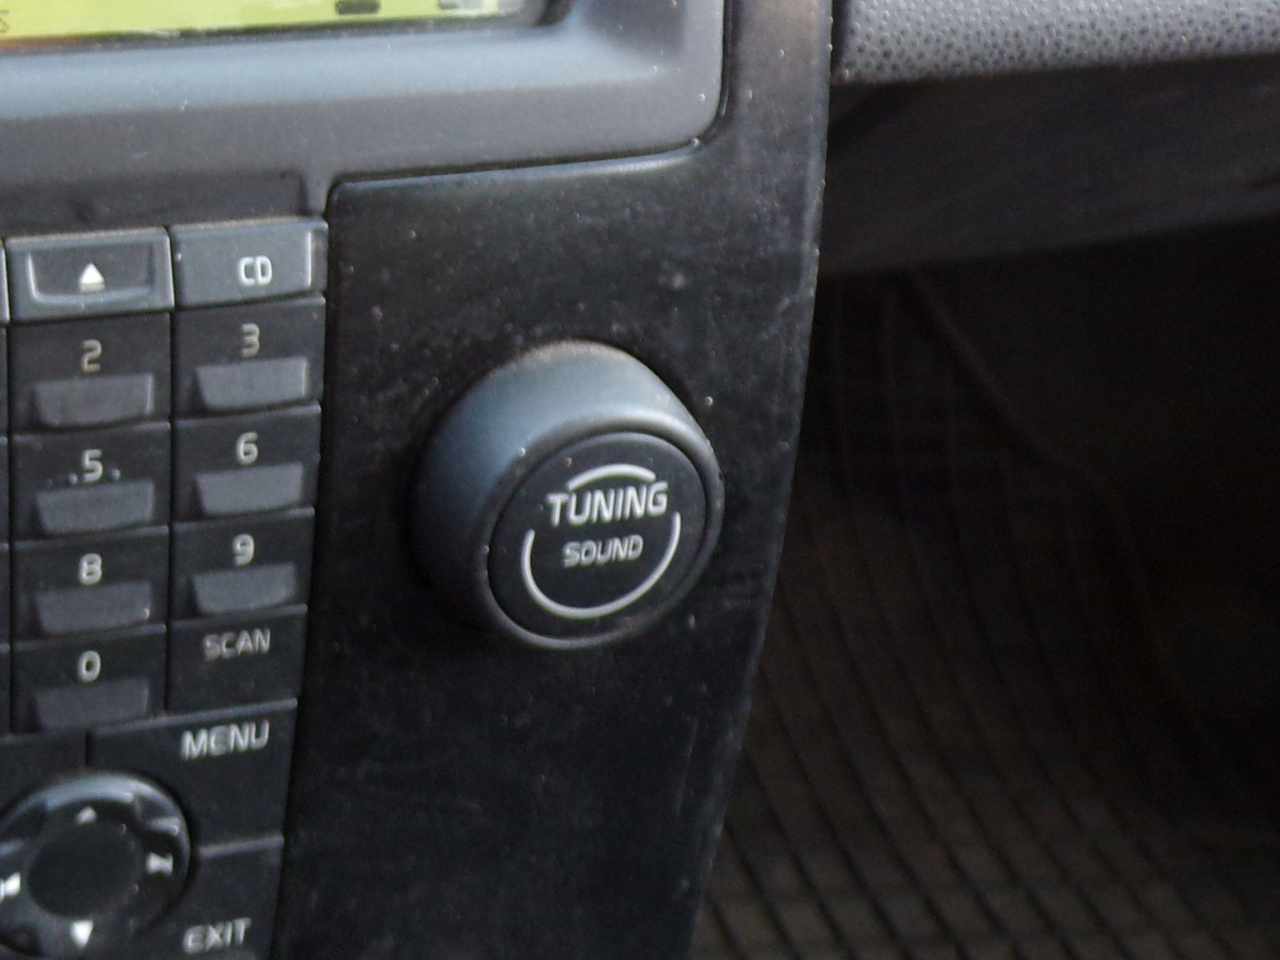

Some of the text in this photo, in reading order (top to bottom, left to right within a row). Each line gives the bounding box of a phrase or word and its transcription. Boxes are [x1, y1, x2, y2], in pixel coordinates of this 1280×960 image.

[238, 255, 274, 288] CD
[80, 339, 103, 373] 2
[240, 322, 262, 358] 3
[235, 431, 259, 465] 6
[81, 449, 104, 483] 5
[547, 481, 669, 527] TUNING
[233, 533, 256, 566] 9
[563, 534, 644, 568] SOUND
[78, 553, 103, 585] 8
[204, 628, 272, 662] SCAN
[180, 720, 270, 761] MENU
[183, 917, 253, 955] EXIT
